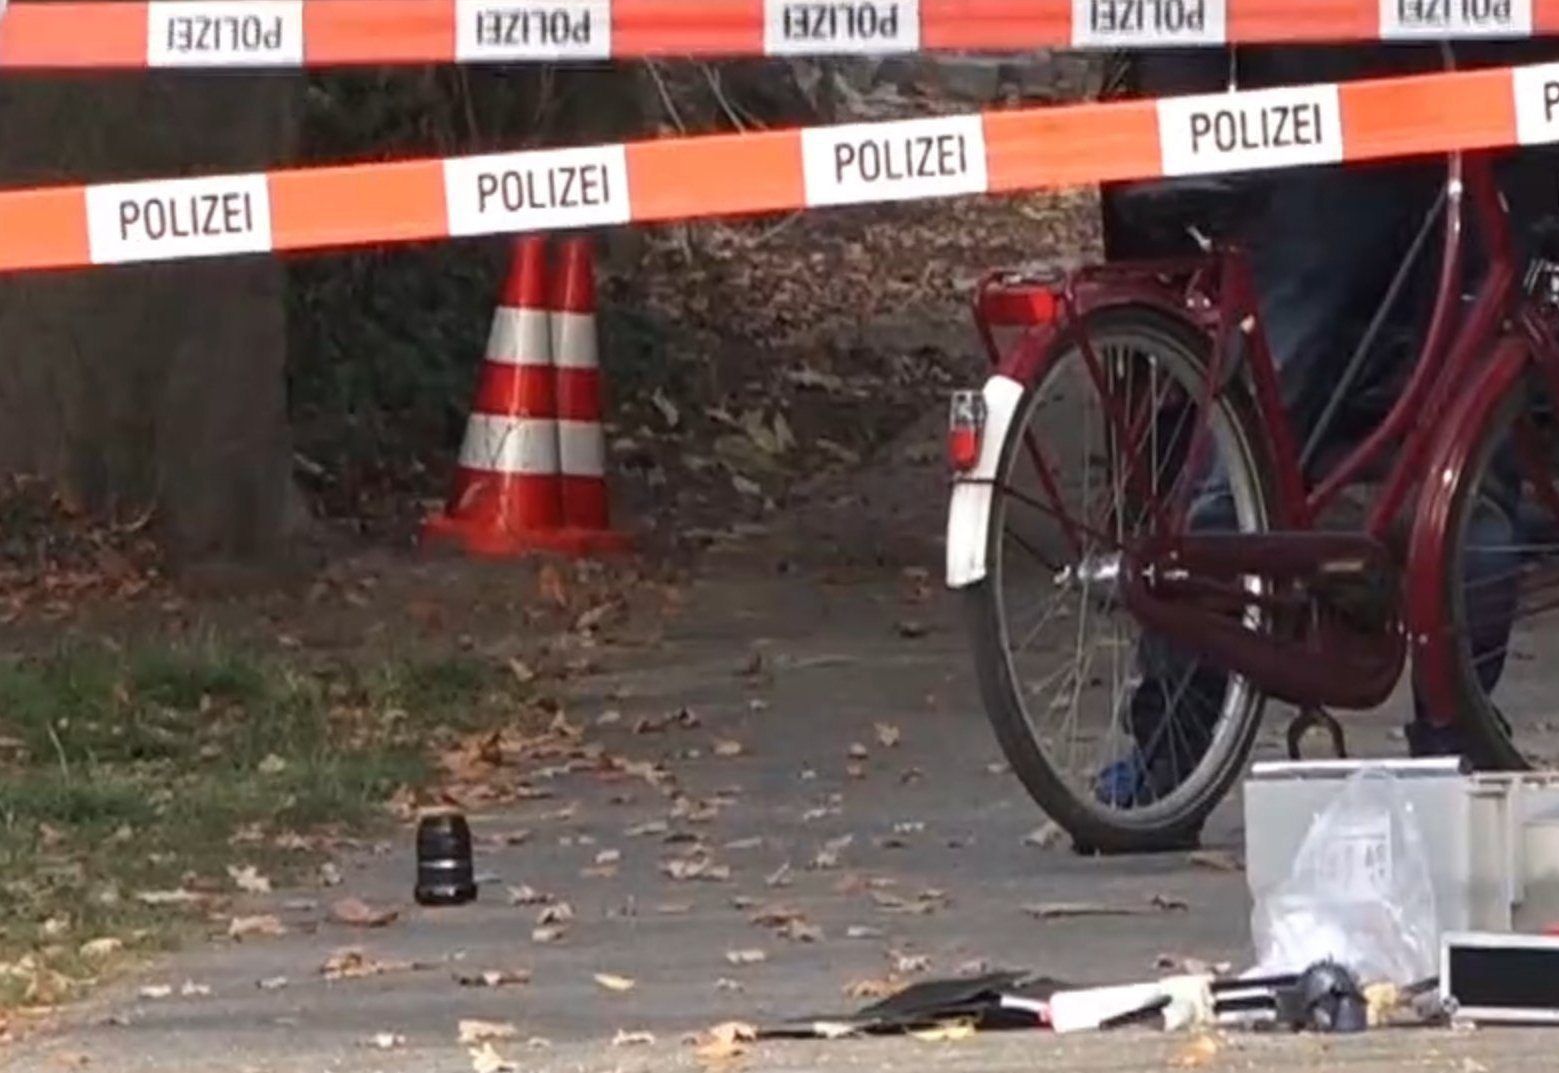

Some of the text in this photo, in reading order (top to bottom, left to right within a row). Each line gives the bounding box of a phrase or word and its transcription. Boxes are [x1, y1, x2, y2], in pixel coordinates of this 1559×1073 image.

[167, 16, 283, 51] POLIZEI
[476, 10, 592, 46] POLIZEI
[783, 2, 898, 39] POLIZEI
[1190, 104, 1323, 153] POLIZEI
[834, 134, 967, 183] POLIZEI
[477, 165, 609, 213] POLIZEI
[119, 192, 253, 241] POLIZEI
